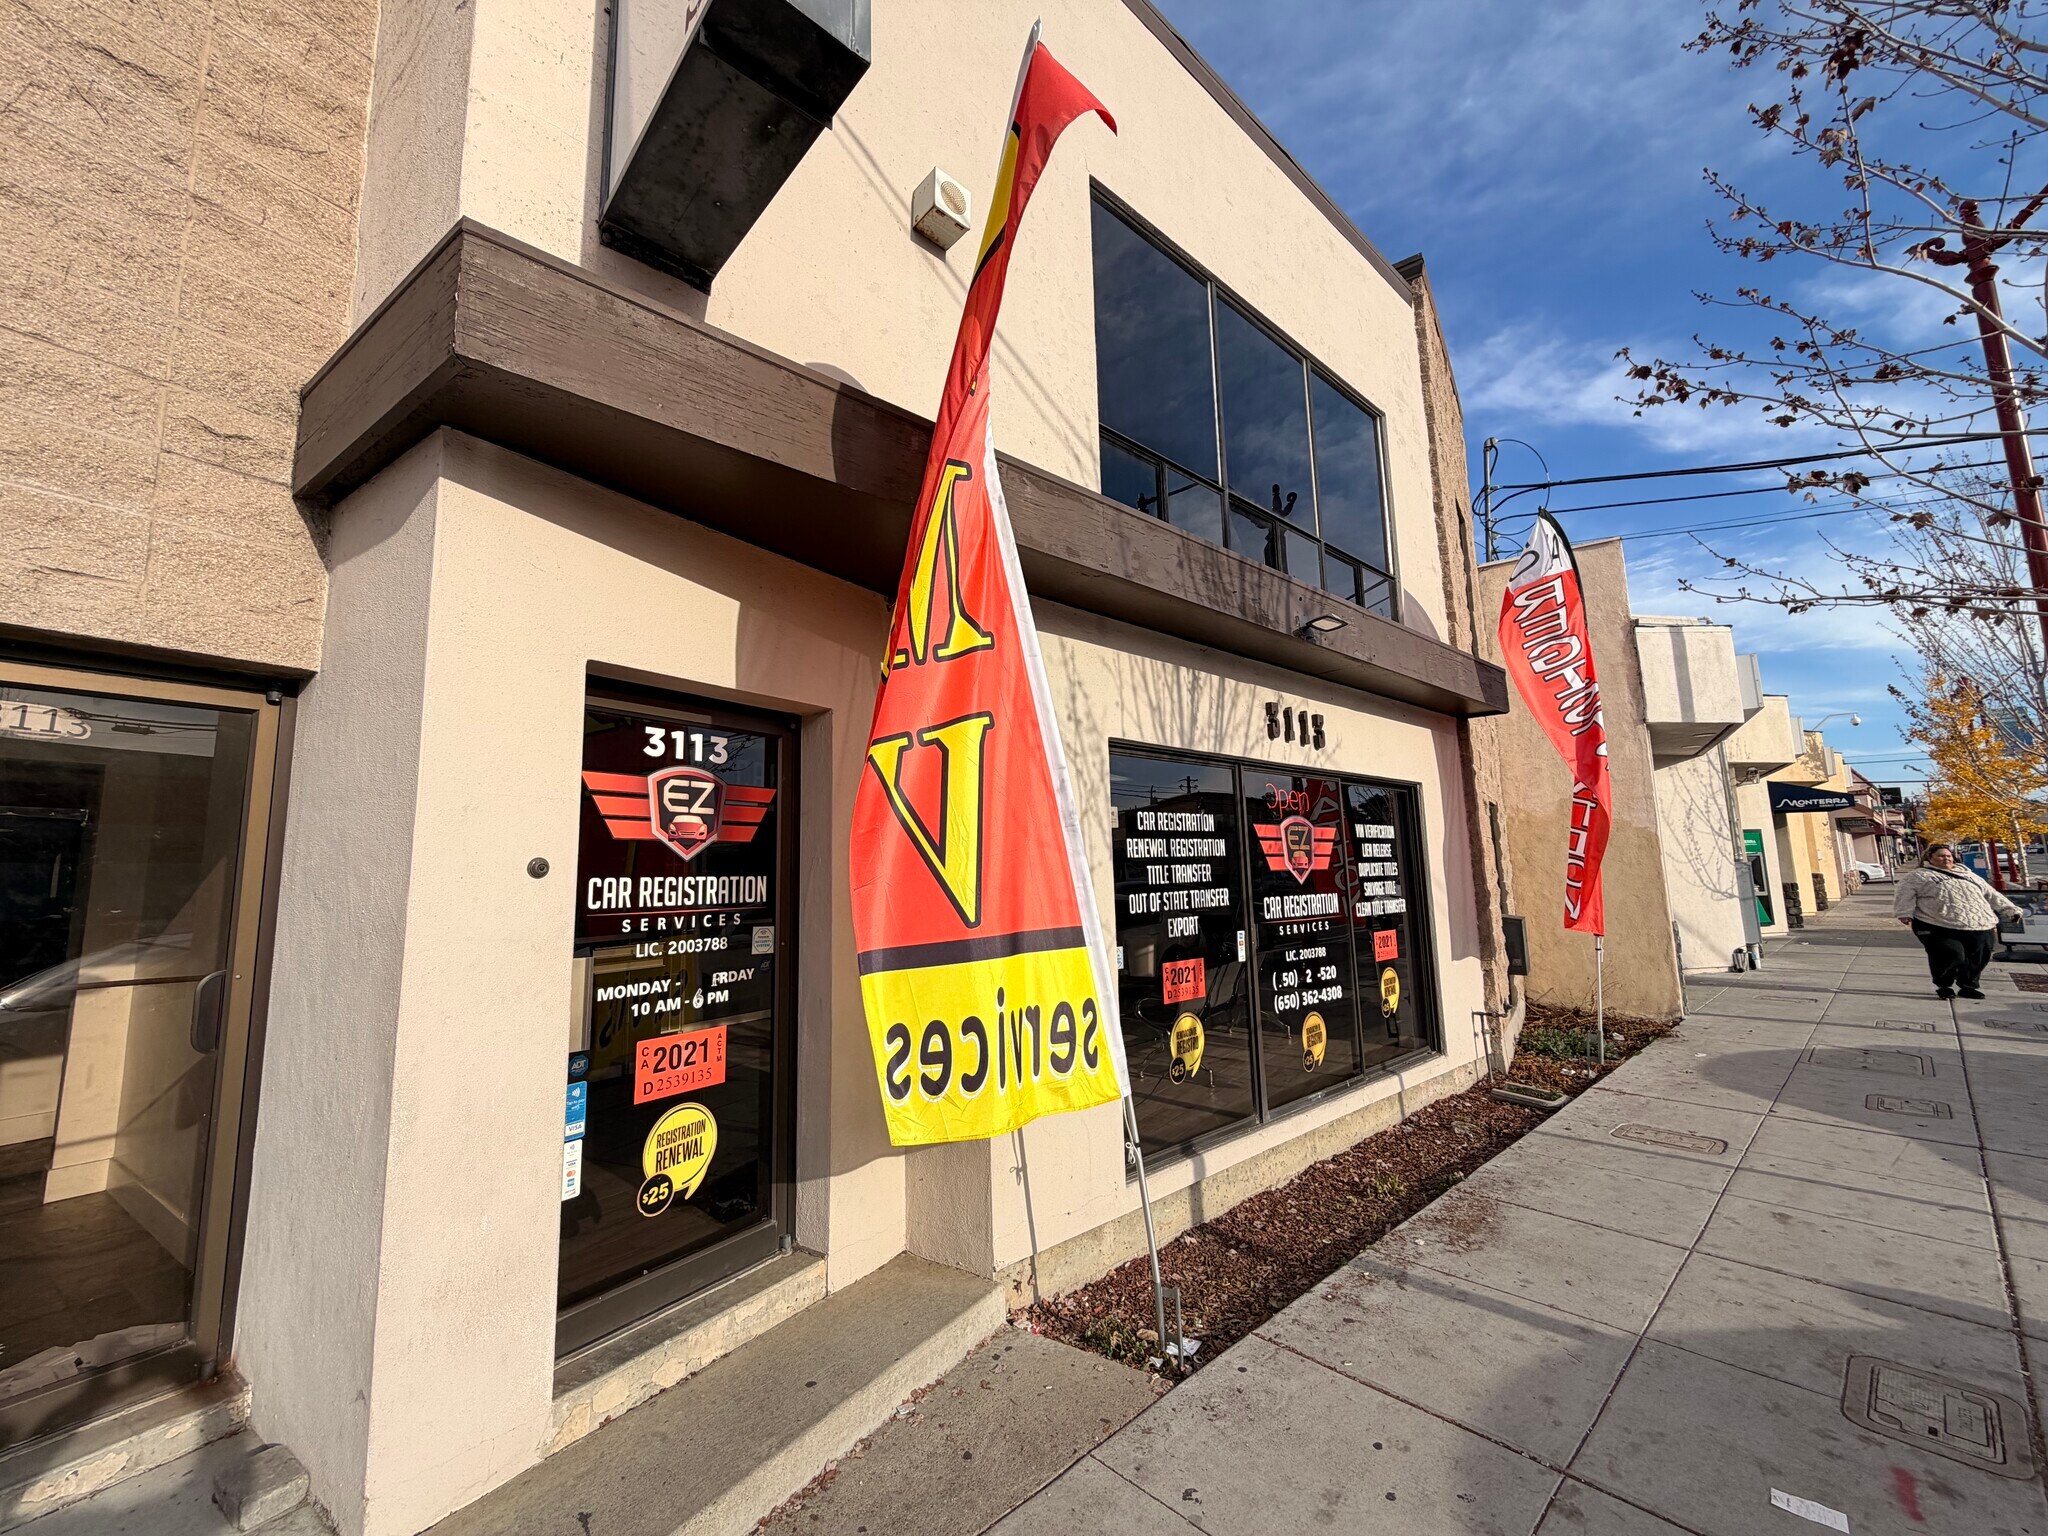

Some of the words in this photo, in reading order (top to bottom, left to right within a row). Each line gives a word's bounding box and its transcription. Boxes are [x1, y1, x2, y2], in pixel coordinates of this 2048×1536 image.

[0, 704, 88, 737] 113
[1265, 702, 1326, 751] 3113
[643, 726, 728, 764] 3113
[663, 779, 715, 815] EZ
[1137, 811, 1156, 831] CAR
[1157, 812, 1215, 832] REGISTRATION
[1126, 838, 1168, 858] RENEWAL
[1170, 838, 1226, 857] REGISTRATION
[1288, 825, 1310, 850] EZ
[1146, 865, 1169, 885] TITLE
[1170, 864, 1212, 884] TRANSFER
[587, 877, 632, 910] CAR
[638, 875, 767, 908] REGISTRATION
[1128, 893, 1147, 914] OUT
[1149, 892, 1162, 912] OF
[1163, 890, 1189, 911] STATE
[1189, 887, 1230, 909] TRANSFER
[1263, 896, 1282, 920] CAR
[1283, 892, 1340, 918] REGISTRATION
[621, 913, 741, 933] SERVICES
[1167, 916, 1199, 938] EXPORT
[1279, 920, 1330, 936] SERVICES
[636, 942, 663, 958] LIC.
[668, 937, 728, 956] 2003788
[1378, 935, 1393, 949] 2021
[1285, 950, 1299, 962] LIC.
[1299, 947, 1327, 960] 2003788
[1170, 965, 1197, 987] 2021
[597, 979, 672, 1002] MONDAY
[631, 1002, 650, 1017] 10
[655, 997, 681, 1014] AM
[692, 987, 704, 1009] 6
[707, 989, 729, 1005] PM
[1274, 991, 1300, 1014] (650)
[1302, 985, 1343, 1006] 362-4308
[571, 1059, 586, 1070] ADT
[652, 1037, 709, 1074] 2021
[1172, 1063, 1184, 1077] $25
[568, 1124, 582, 1132] VISA
[656, 1118, 706, 1149] REGISTRATION
[655, 1136, 704, 1173] RENEWAL
[642, 1181, 669, 1205] $25
